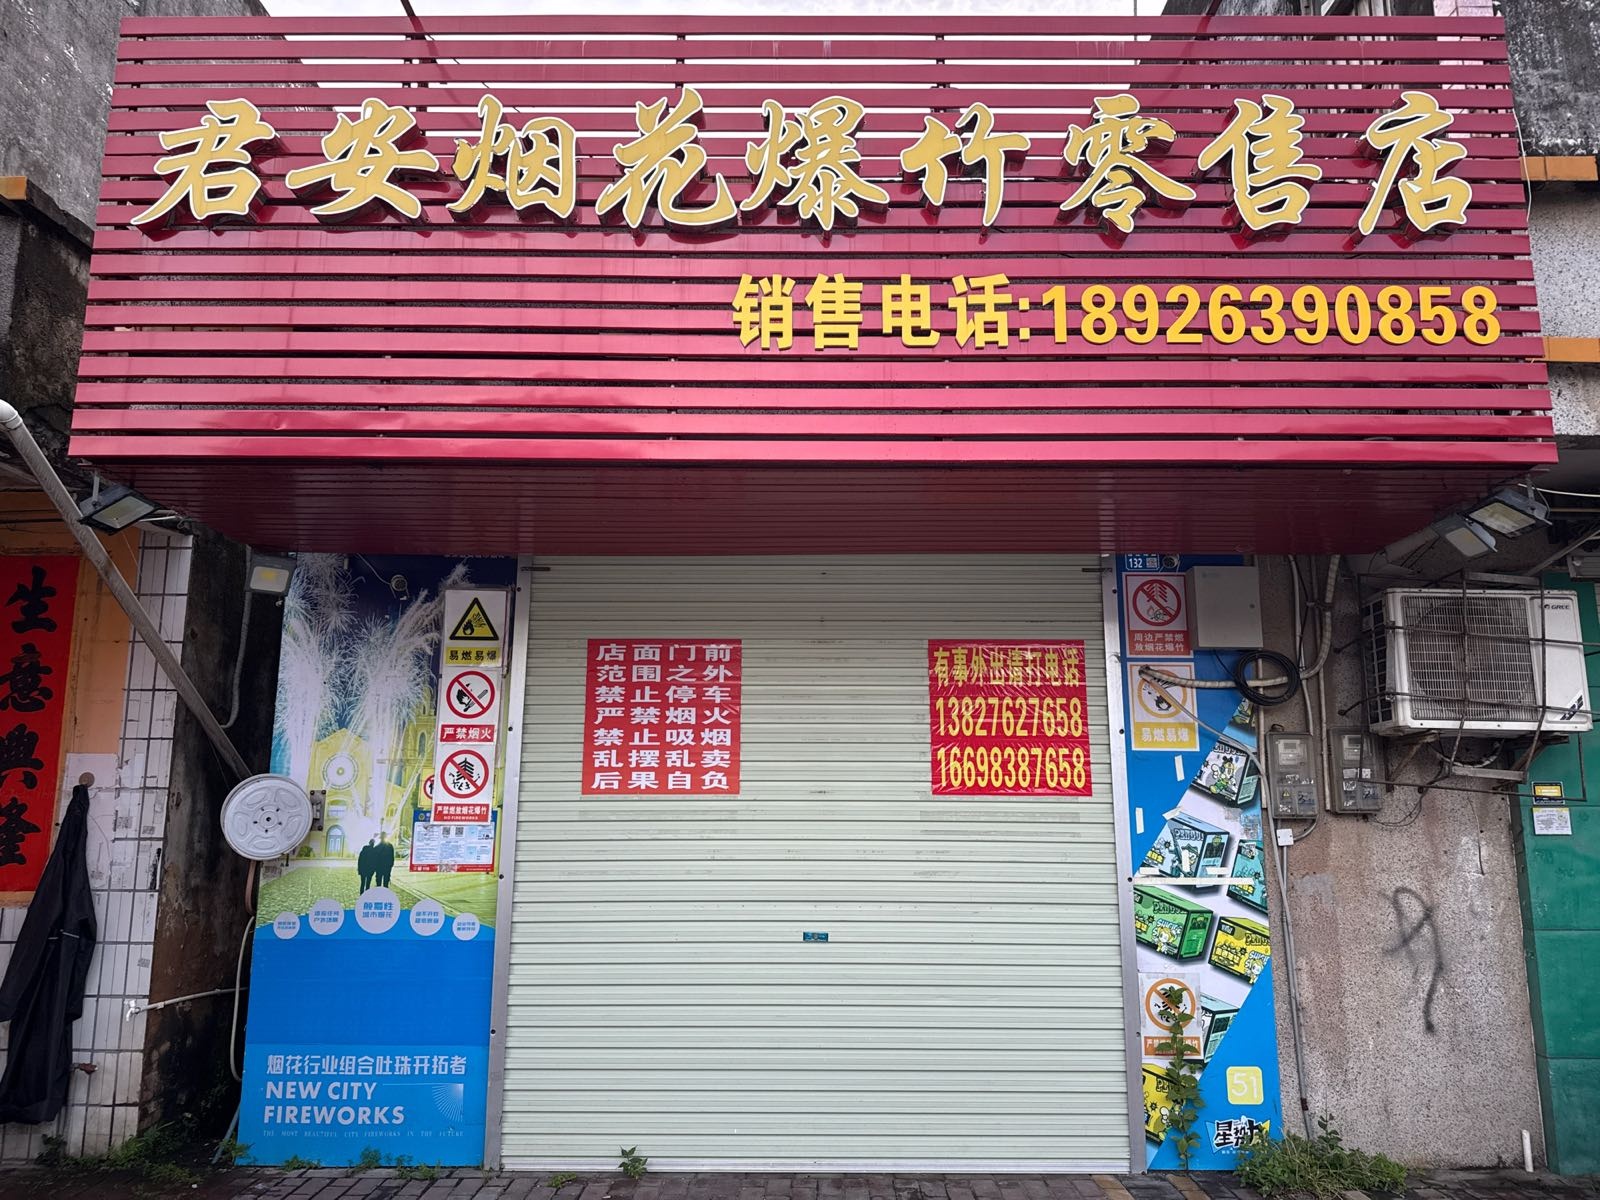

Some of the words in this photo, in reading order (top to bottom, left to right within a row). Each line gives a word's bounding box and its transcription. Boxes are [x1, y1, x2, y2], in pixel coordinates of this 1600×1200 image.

[130, 87, 1473, 235] 君安烟花爆竹零售店
[1129, 558, 1142, 568] 132
[449, 650, 496, 661] 易燃易爆
[596, 644, 733, 661] 店面门前
[597, 665, 733, 682] 范围之外
[933, 647, 1080, 687] 有事外出请打电话
[595, 686, 731, 703] 禁止停车
[594, 707, 731, 725] 严禁烟火
[935, 697, 1083, 737] 13827627658
[442, 727, 491, 740] 严禁烟火
[593, 728, 731, 746] 禁止吸烟
[1141, 727, 1190, 743] 易燃易爆
[592, 750, 731, 768] 乱摆乱卖
[937, 746, 1086, 788] 16698387658
[591, 771, 729, 790] 后果自负
[266, 1055, 467, 1075] 烟花行业组合吐珠开拓者
[265, 1081, 322, 1100] NEW
[327, 1081, 377, 1101] CITY
[263, 1105, 405, 1125] FIREWORKS
